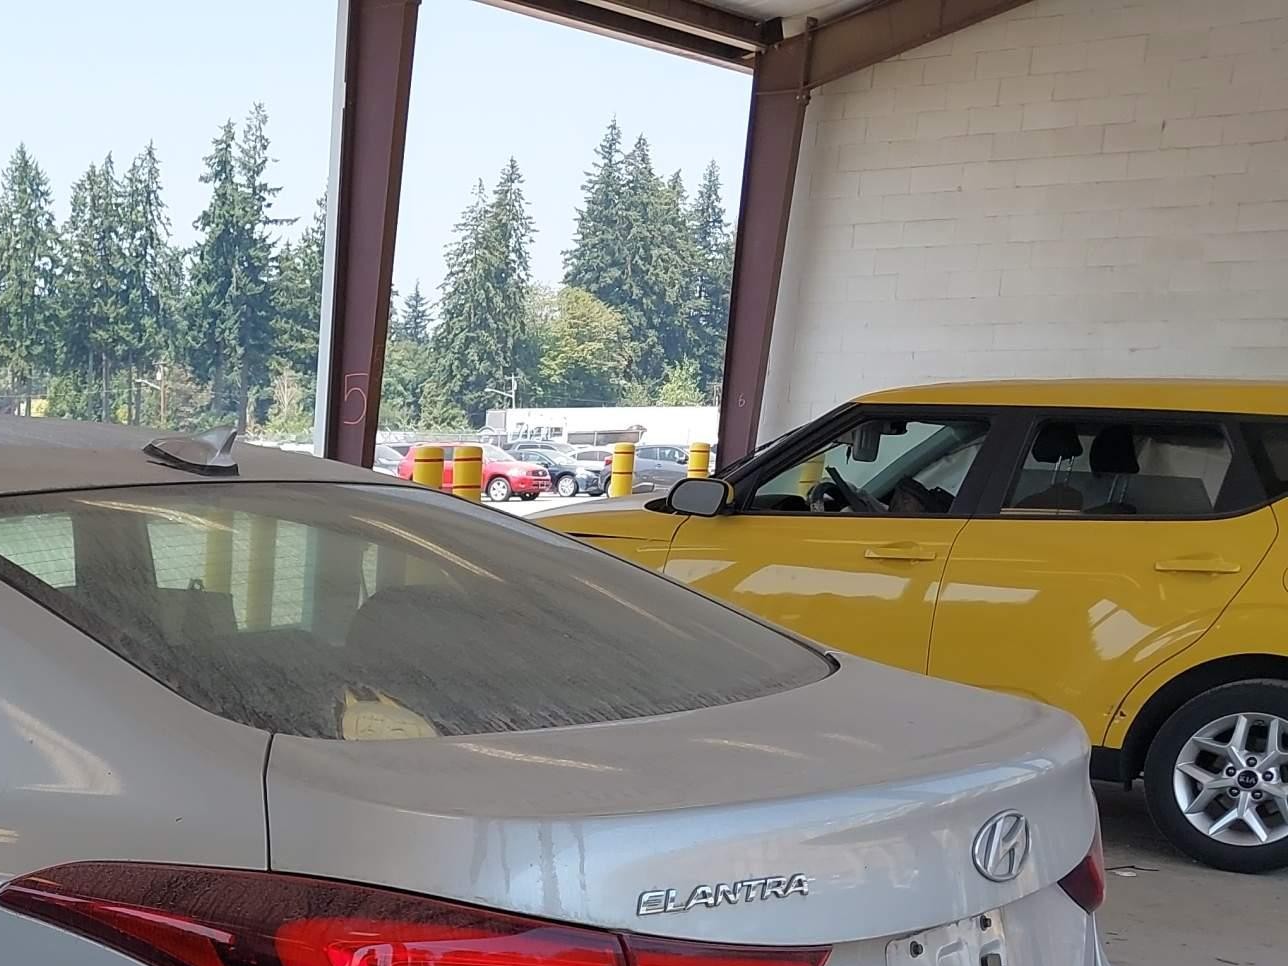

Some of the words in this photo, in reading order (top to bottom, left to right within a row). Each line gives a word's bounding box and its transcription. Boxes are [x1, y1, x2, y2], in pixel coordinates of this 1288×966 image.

[343, 372, 368, 425] 5
[737, 393, 746, 408] 6
[637, 873, 809, 917] ELANTRA
